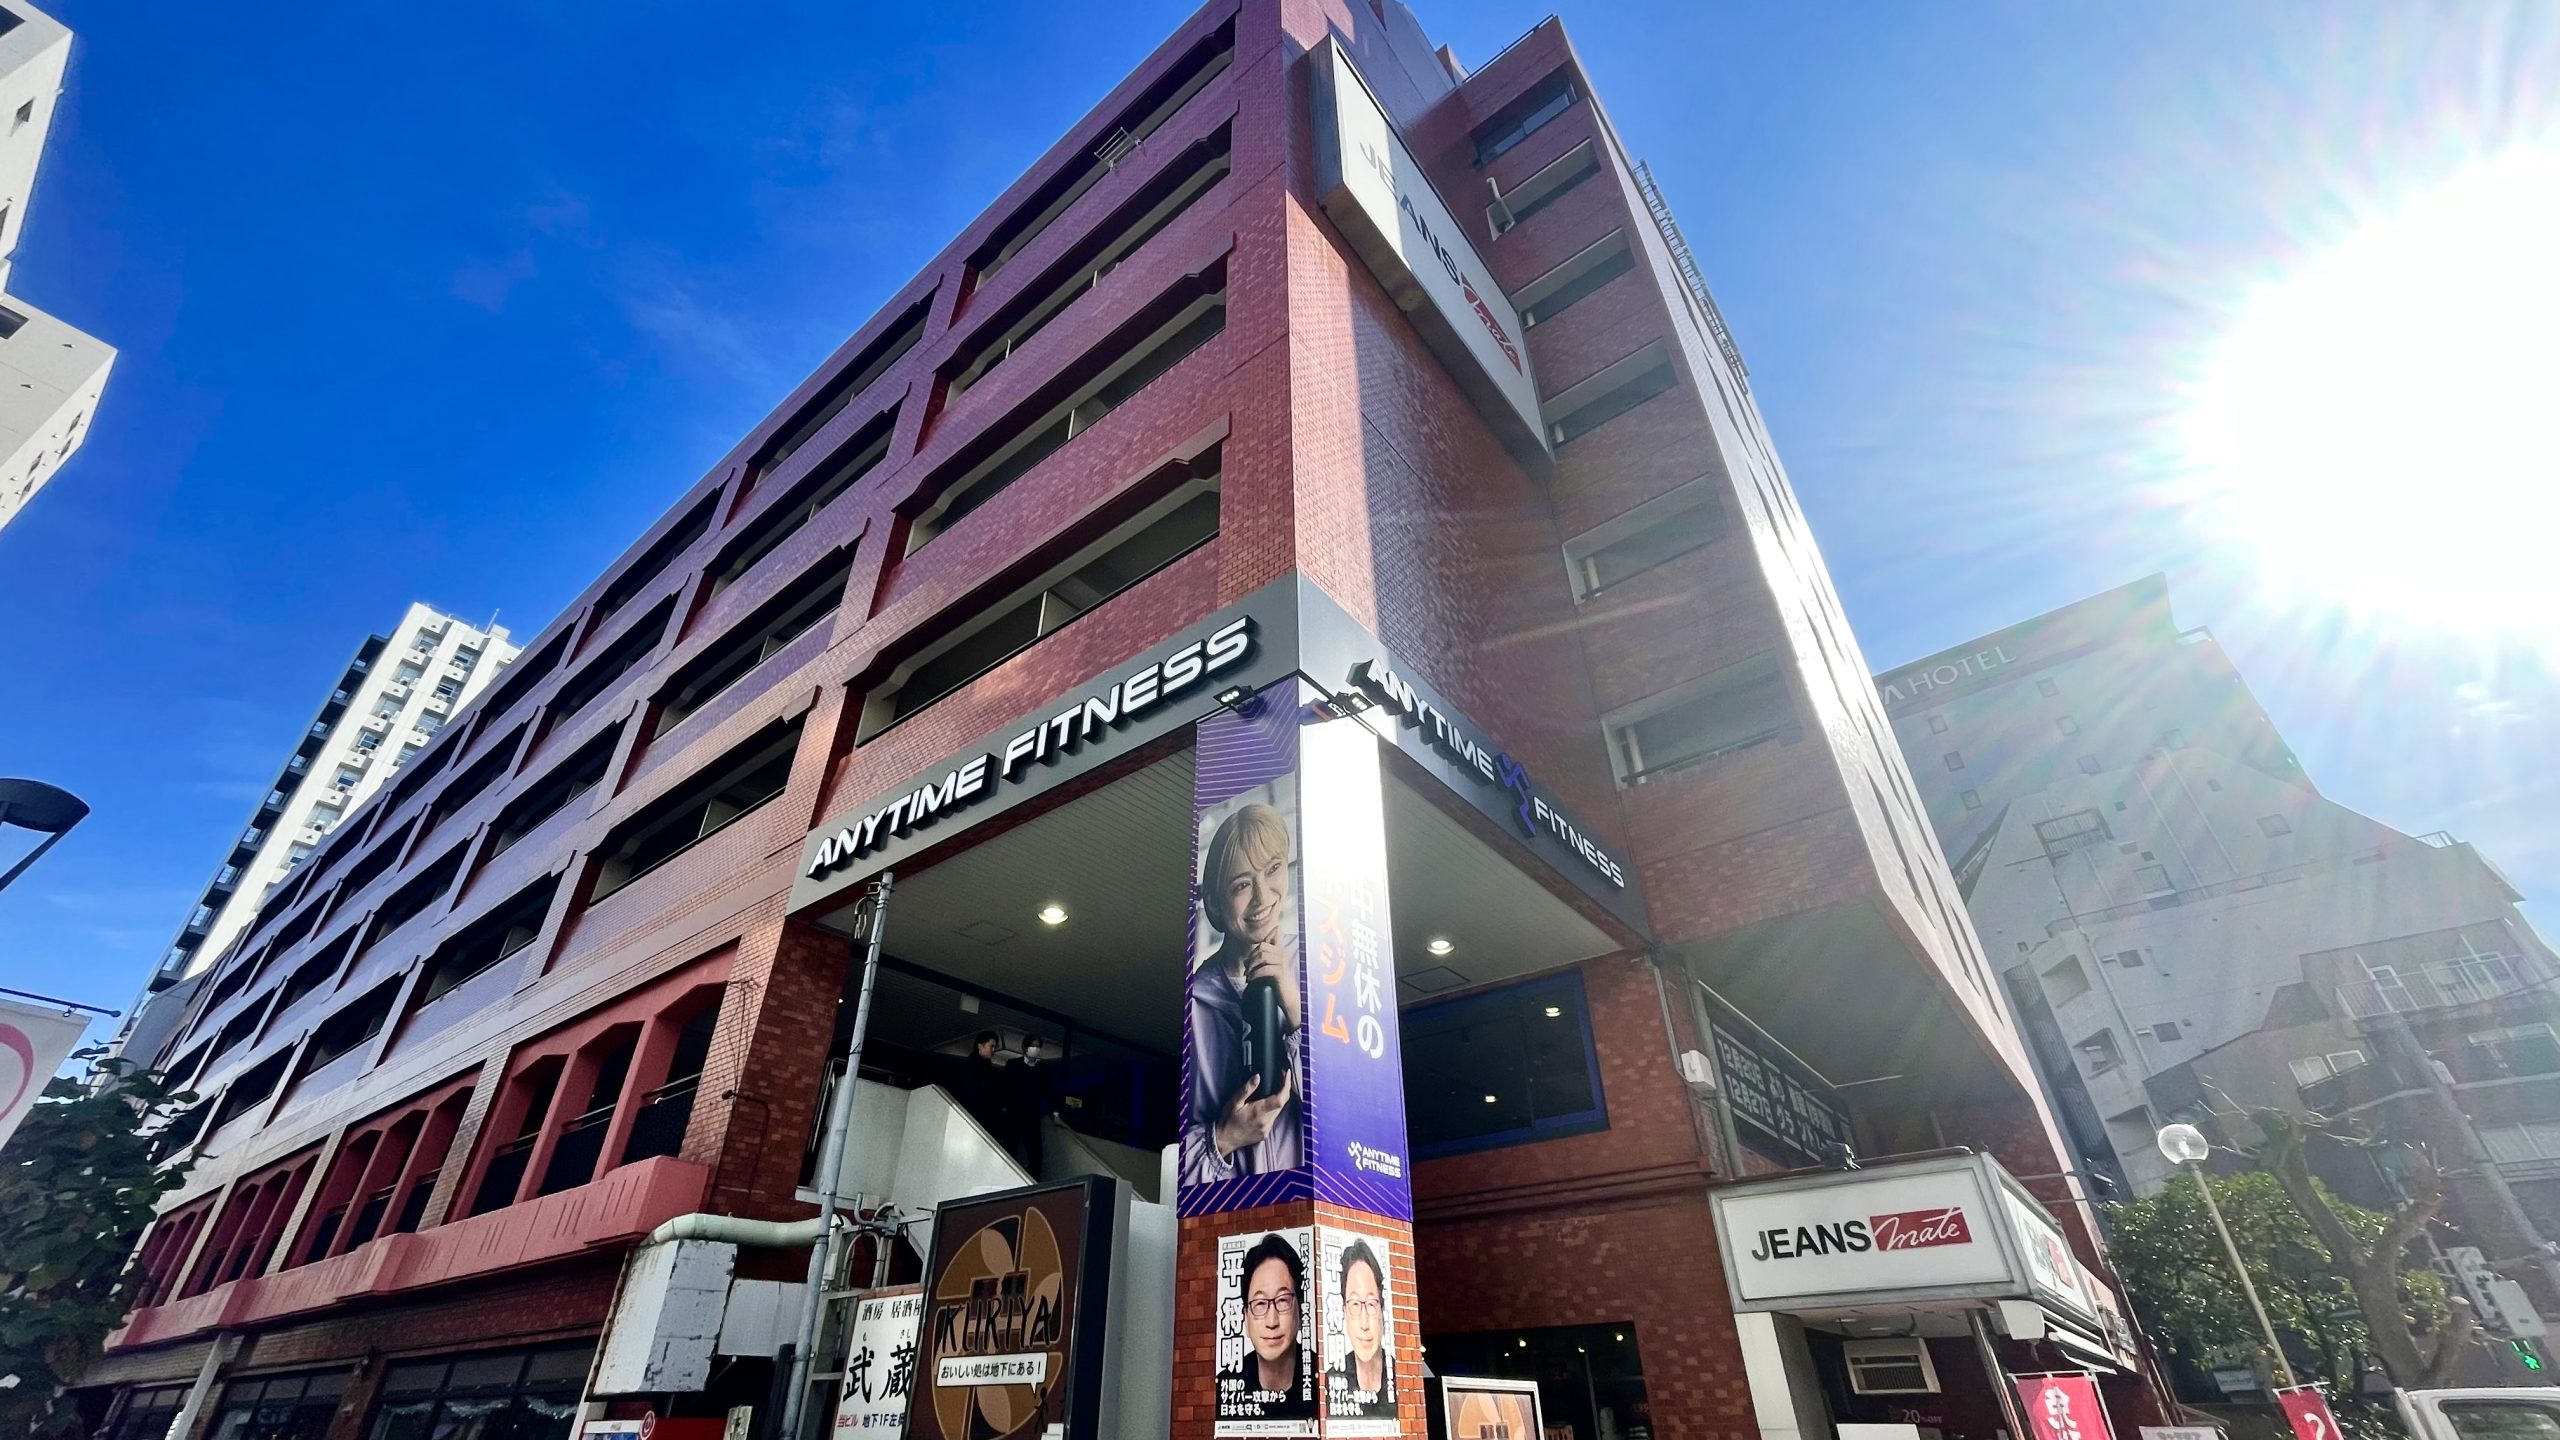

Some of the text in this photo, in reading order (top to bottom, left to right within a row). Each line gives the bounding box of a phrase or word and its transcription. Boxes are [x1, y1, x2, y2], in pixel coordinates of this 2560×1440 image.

[1360, 140, 1461, 286] JEANS
[1907, 645, 2017, 695] HOTEL
[806, 615, 1255, 878] ANYTIME FITNESS
[1366, 657, 1625, 889] ANYTIME FITNESS
[1362, 1146, 1400, 1168] ANYTIME
[1362, 1157, 1401, 1178] FITNESS
[1751, 1206, 1963, 1262] JEANS mate
[862, 1301, 884, 1321] 酒房
[942, 1294, 1052, 1353] KURIYA
[1221, 1250, 1245, 1373] 平将明
[1220, 1379, 1245, 1392] 外国の
[1220, 1390, 1287, 1404] サイバー攻撃から
[837, 1413, 858, 1428] 当ビル
